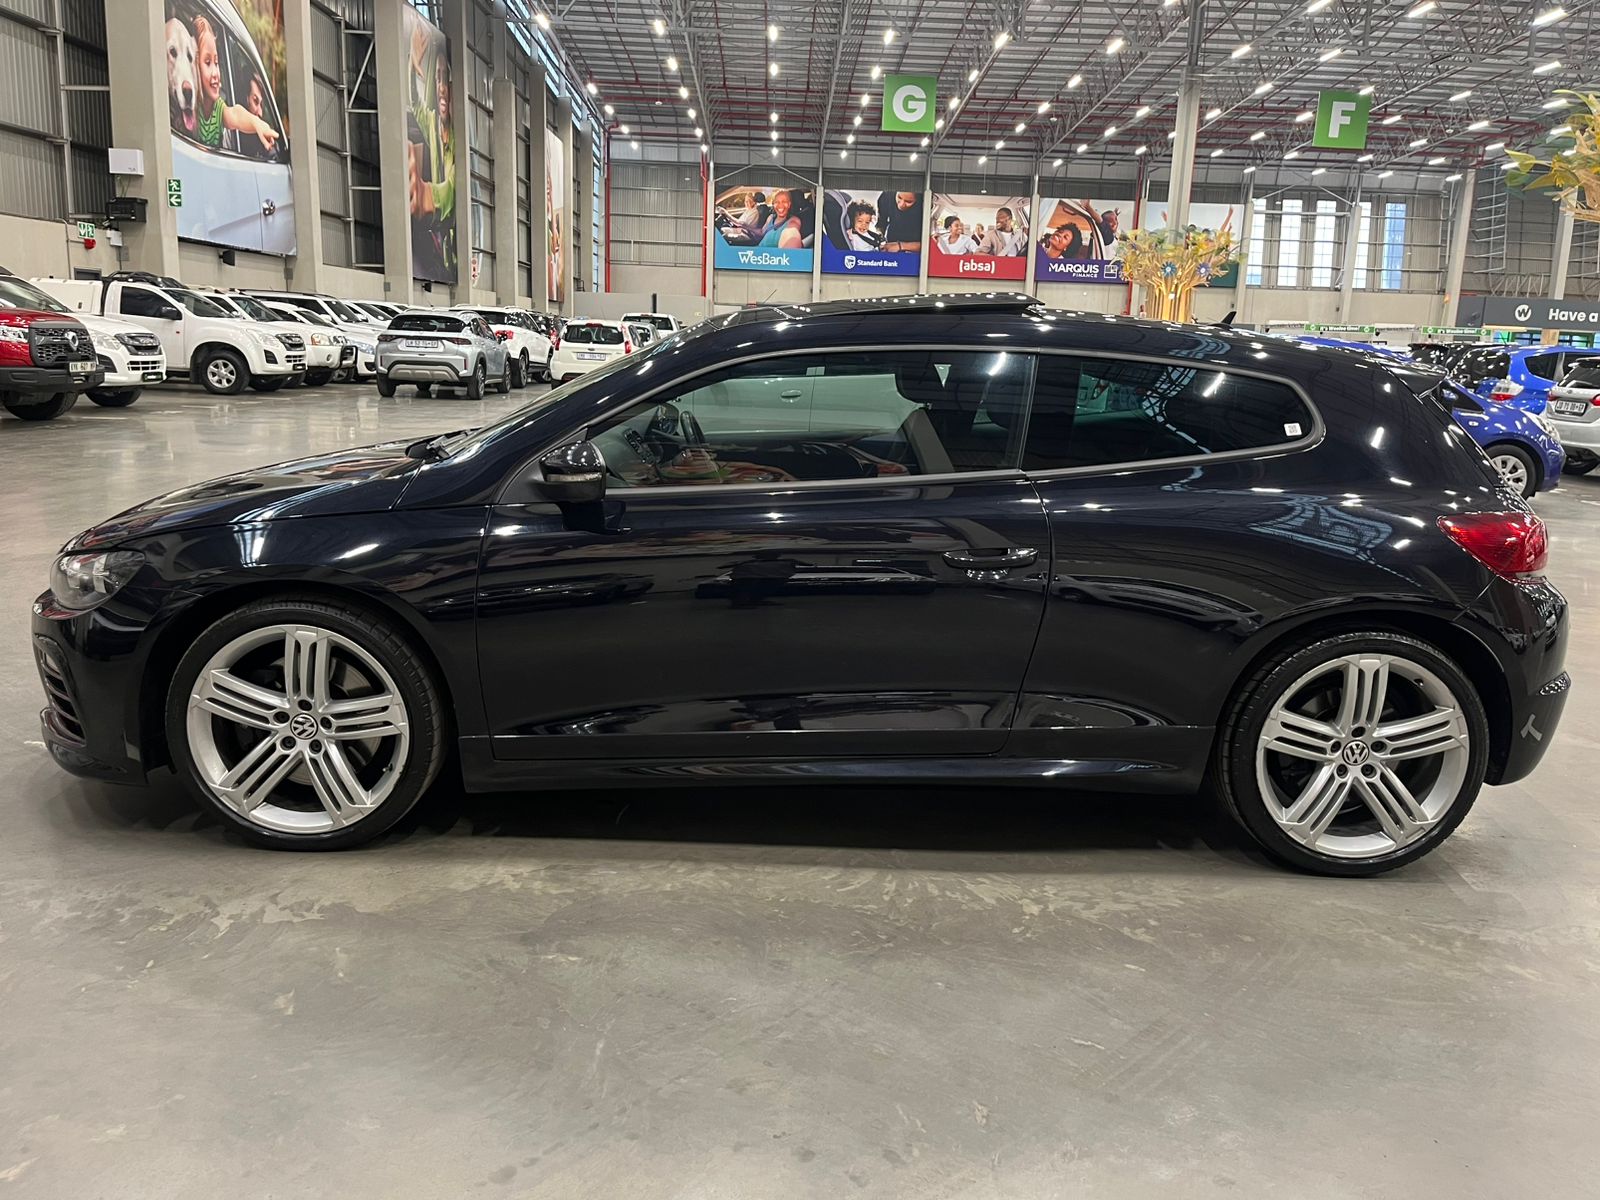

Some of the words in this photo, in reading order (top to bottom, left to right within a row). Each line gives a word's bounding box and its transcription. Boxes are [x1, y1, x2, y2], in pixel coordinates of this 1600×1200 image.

[892, 84, 927, 123] G
[1328, 101, 1356, 138] F
[738, 250, 790, 266] WesBank
[857, 259, 882, 267] Standard
[959, 259, 995, 274] (absa)
[1048, 262, 1099, 274] MARQUIS
[1548, 308, 1587, 322] Have
[1588, 312, 1598, 323] a
[1342, 740, 1369, 766] VW
